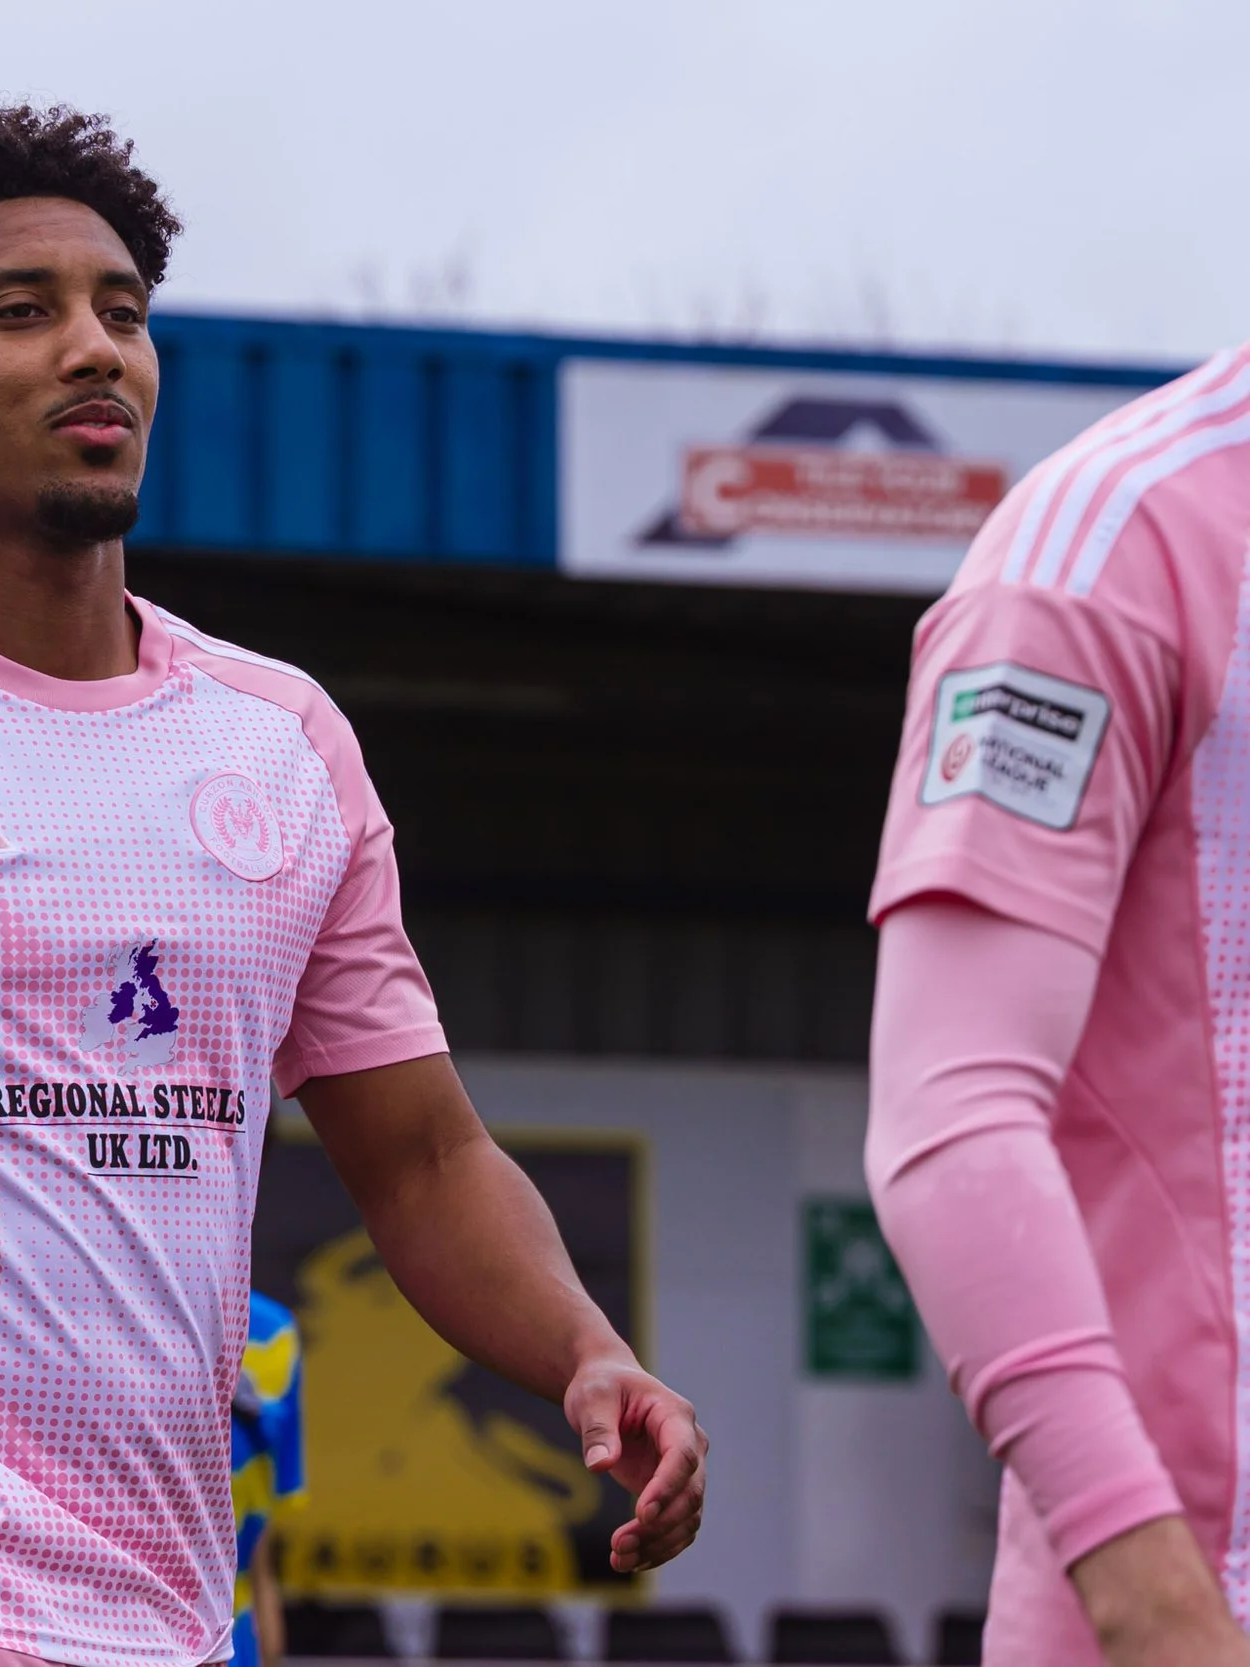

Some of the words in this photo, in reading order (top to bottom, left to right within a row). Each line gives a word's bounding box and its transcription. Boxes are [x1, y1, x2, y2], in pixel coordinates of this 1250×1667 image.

[199, 780, 233, 812] CURZON
[210, 837, 263, 873] FOOTBALL
[153, 1084, 245, 1125] STEELS
[86, 1133, 130, 1169] UK
[138, 1134, 198, 1171] LTD.
